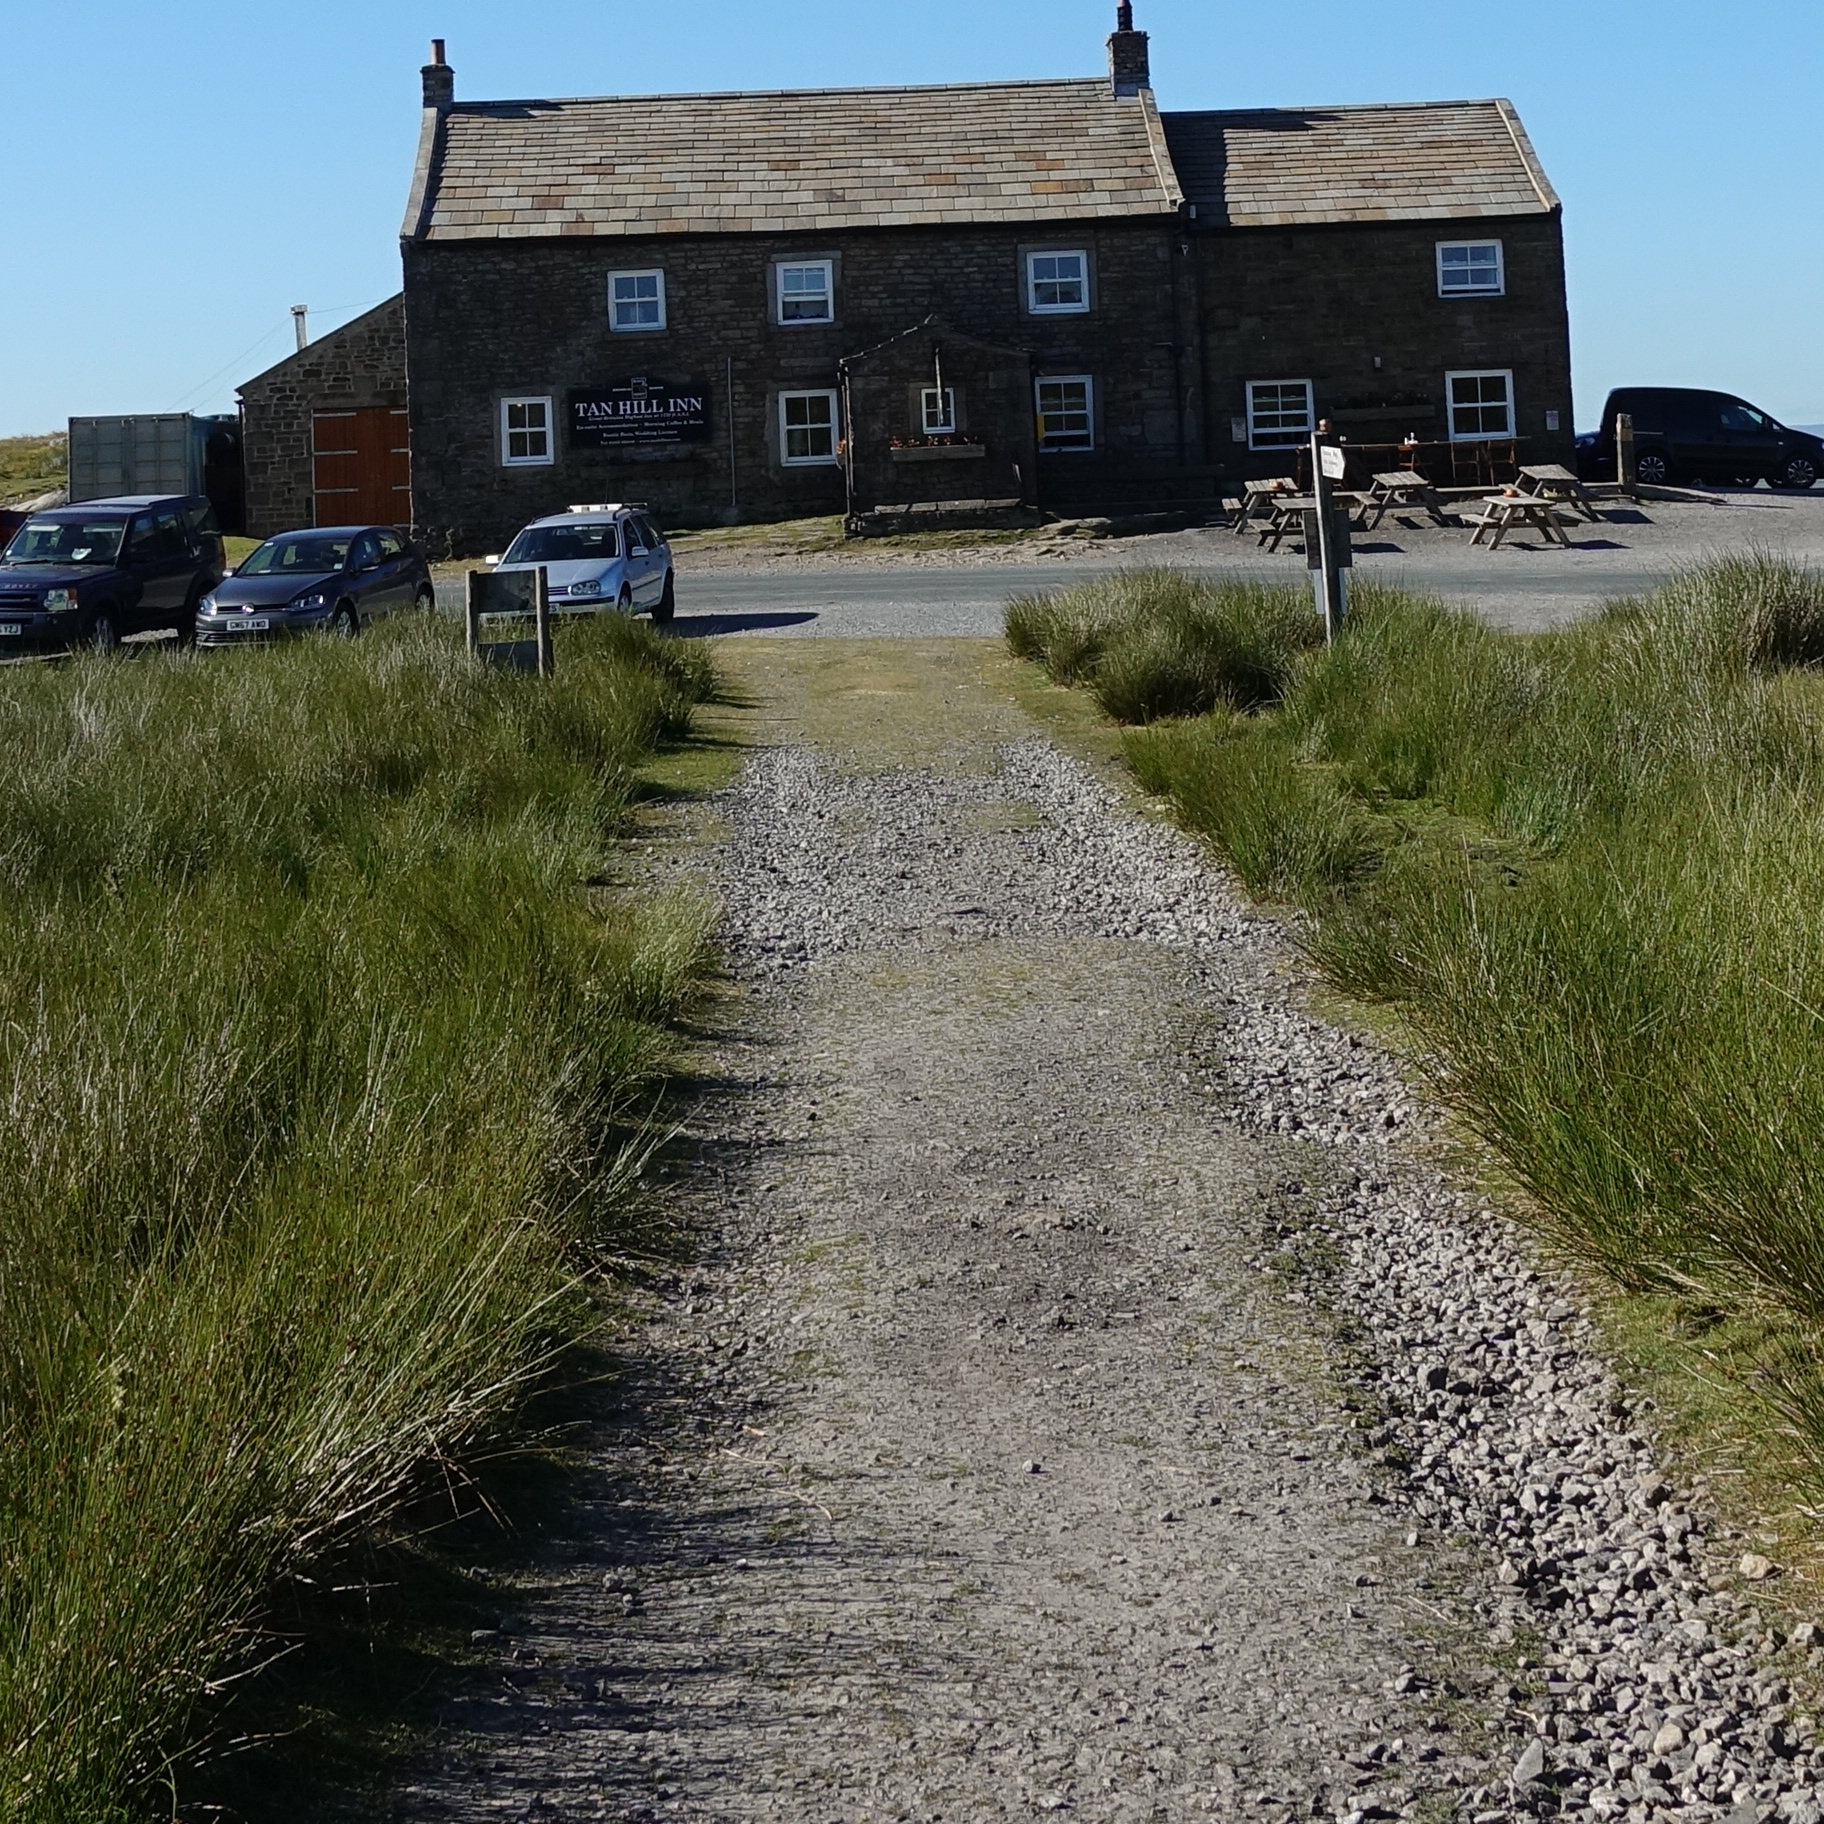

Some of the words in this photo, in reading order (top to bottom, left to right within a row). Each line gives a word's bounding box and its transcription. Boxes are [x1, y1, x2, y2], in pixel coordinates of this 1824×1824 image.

[575, 402, 613, 417] TAN
[618, 400, 664, 415] HILL
[668, 397, 703, 412] INN
